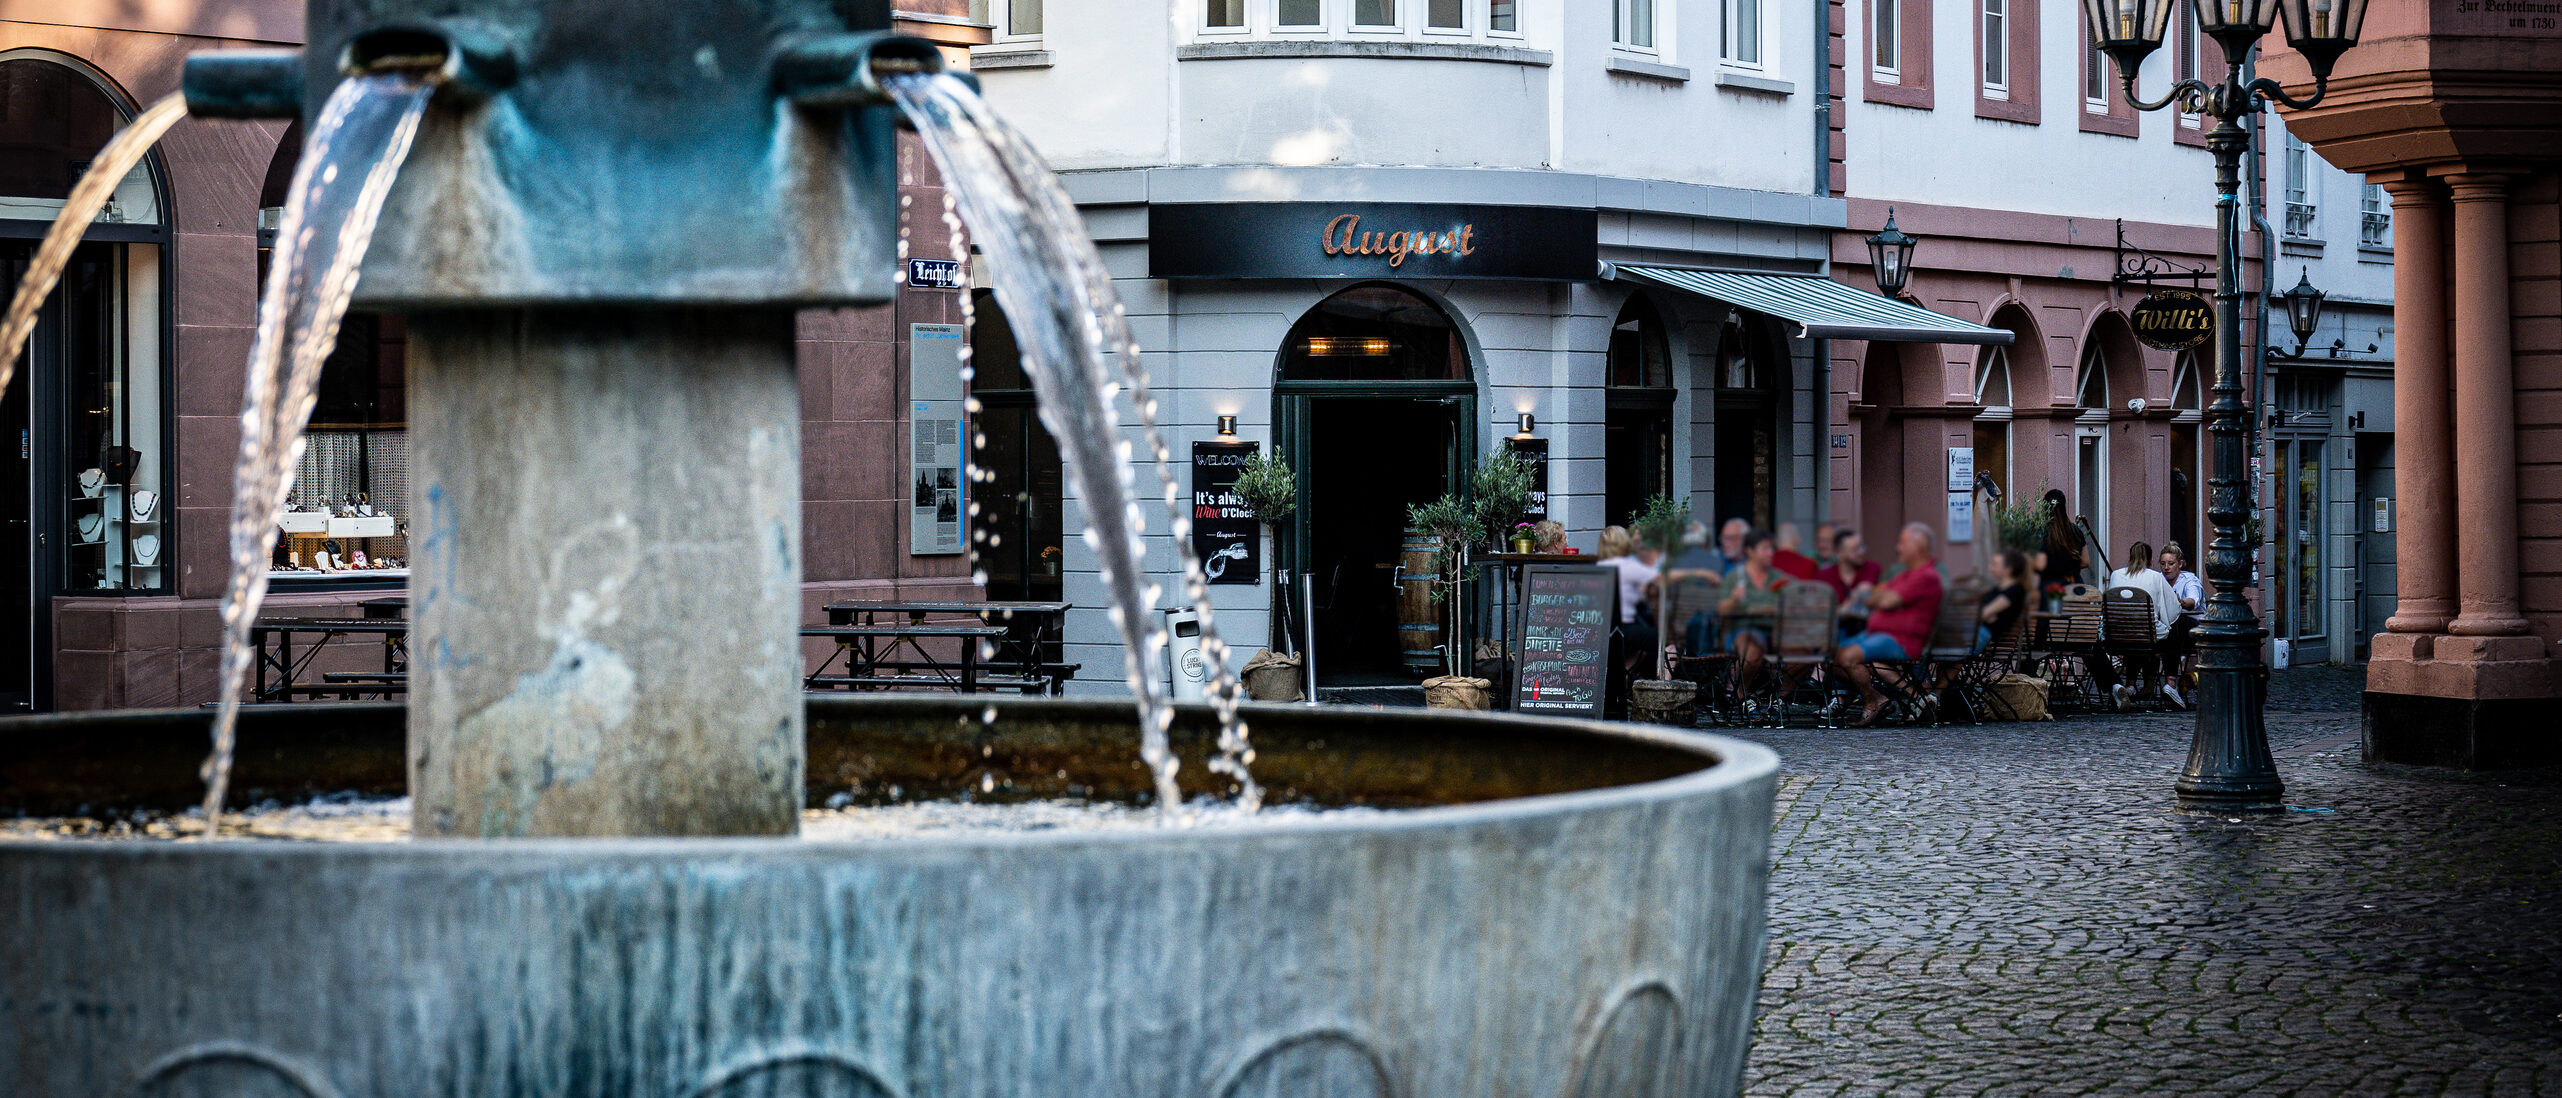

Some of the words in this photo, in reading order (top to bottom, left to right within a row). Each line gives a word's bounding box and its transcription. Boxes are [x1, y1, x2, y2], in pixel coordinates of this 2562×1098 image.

[1321, 213, 1475, 267] August
[2135, 308, 2211, 330] Willi's
[1195, 491, 1215, 505] It's
[1195, 505, 1221, 519] Wine
